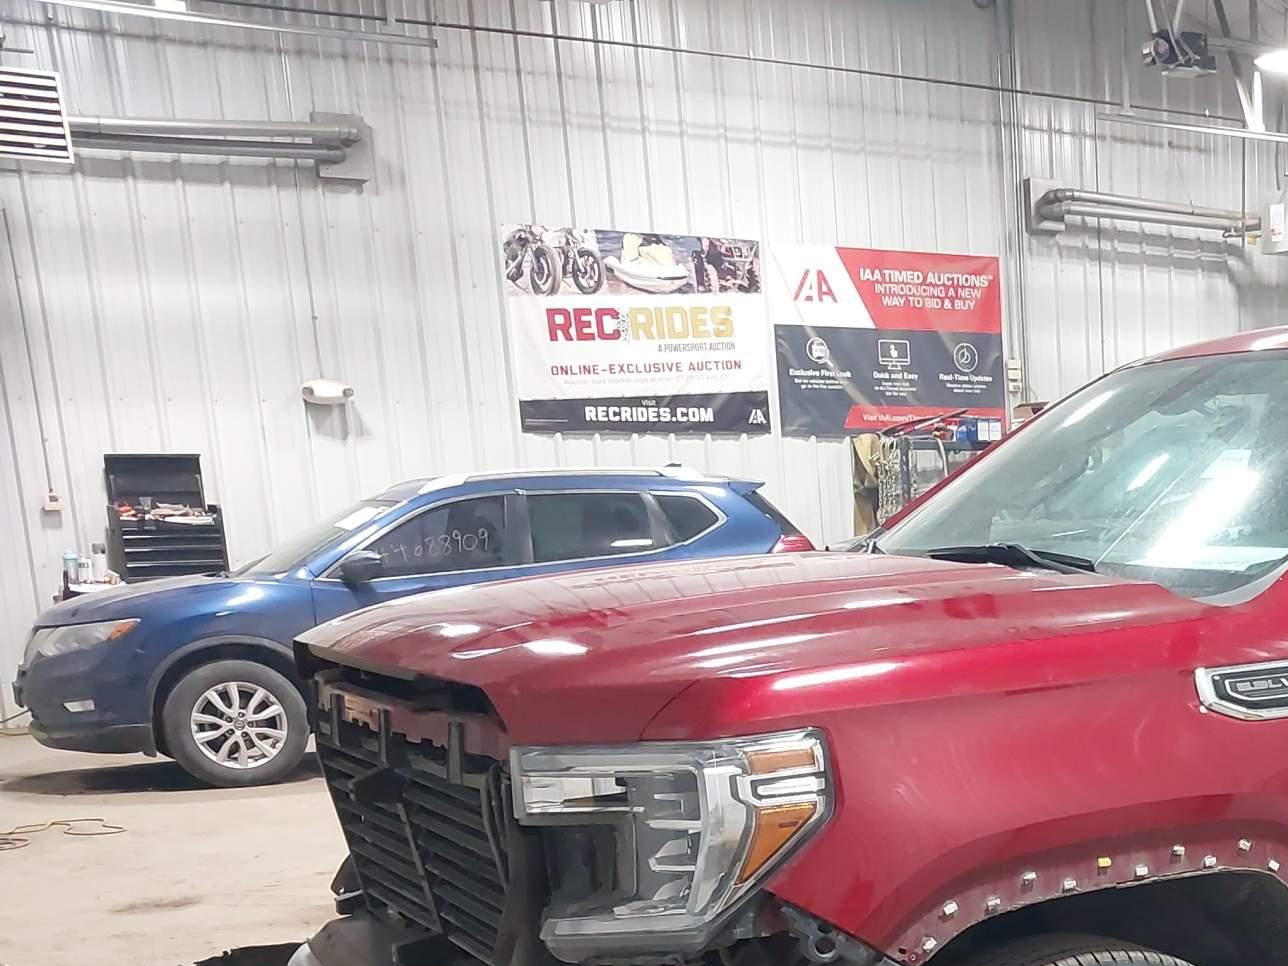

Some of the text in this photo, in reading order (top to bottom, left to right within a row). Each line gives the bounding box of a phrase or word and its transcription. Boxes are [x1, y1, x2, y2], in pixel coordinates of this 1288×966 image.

[860, 268, 882, 281] IAA
[882, 269, 923, 284] TIMED
[874, 283, 982, 299] INTRODUCING A NEW
[882, 295, 975, 311] WAY TO BID & BUY
[546, 306, 735, 342] REC RIDES
[709, 342, 736, 352] AUCTION
[551, 360, 742, 376] ONLINE-EXCLUSIVE AUCTION
[903, 372, 919, 382] Easy
[584, 406, 715, 422] RECRIDES.COM
